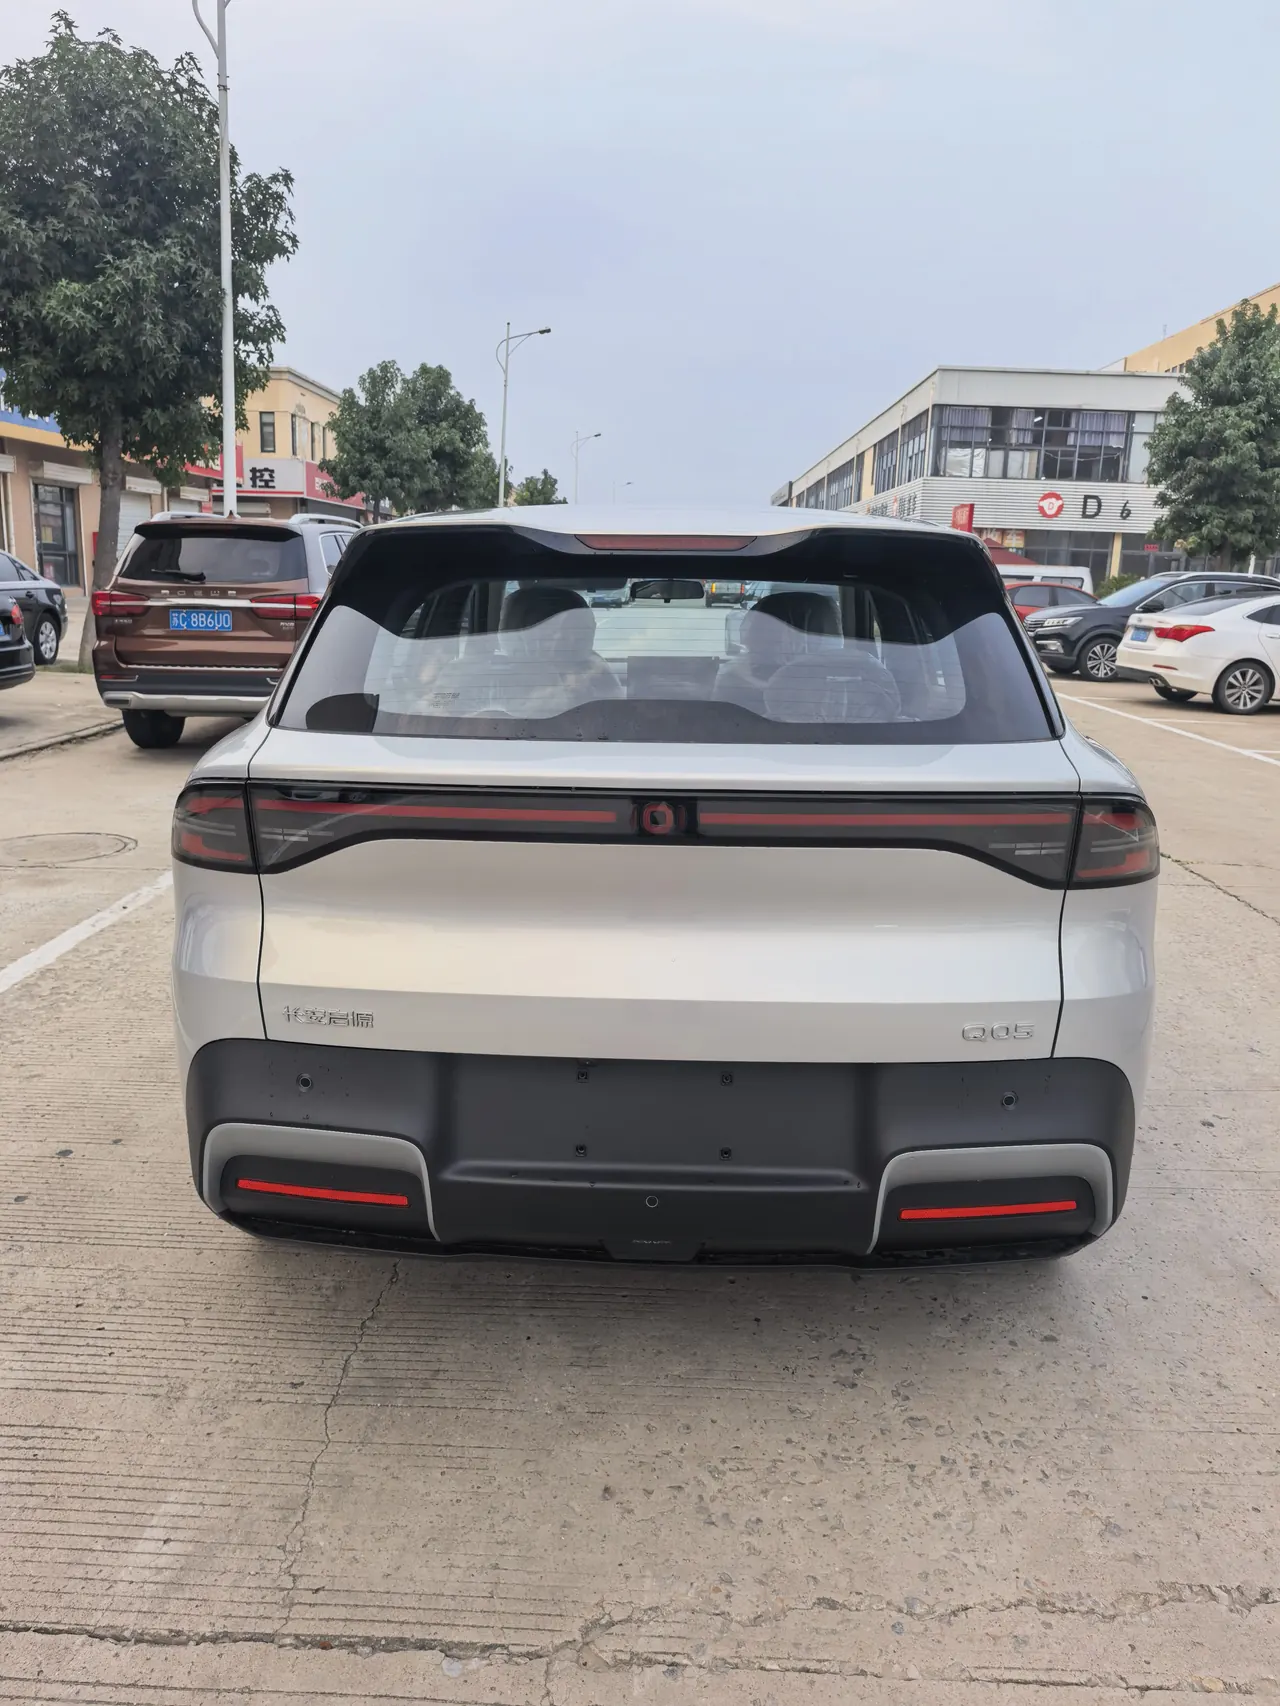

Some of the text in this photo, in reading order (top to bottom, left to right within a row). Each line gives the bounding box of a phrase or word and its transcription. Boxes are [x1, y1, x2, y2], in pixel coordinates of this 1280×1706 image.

[1081, 494, 1132, 520] D 6
[283, 1005, 374, 1028] 长安启源
